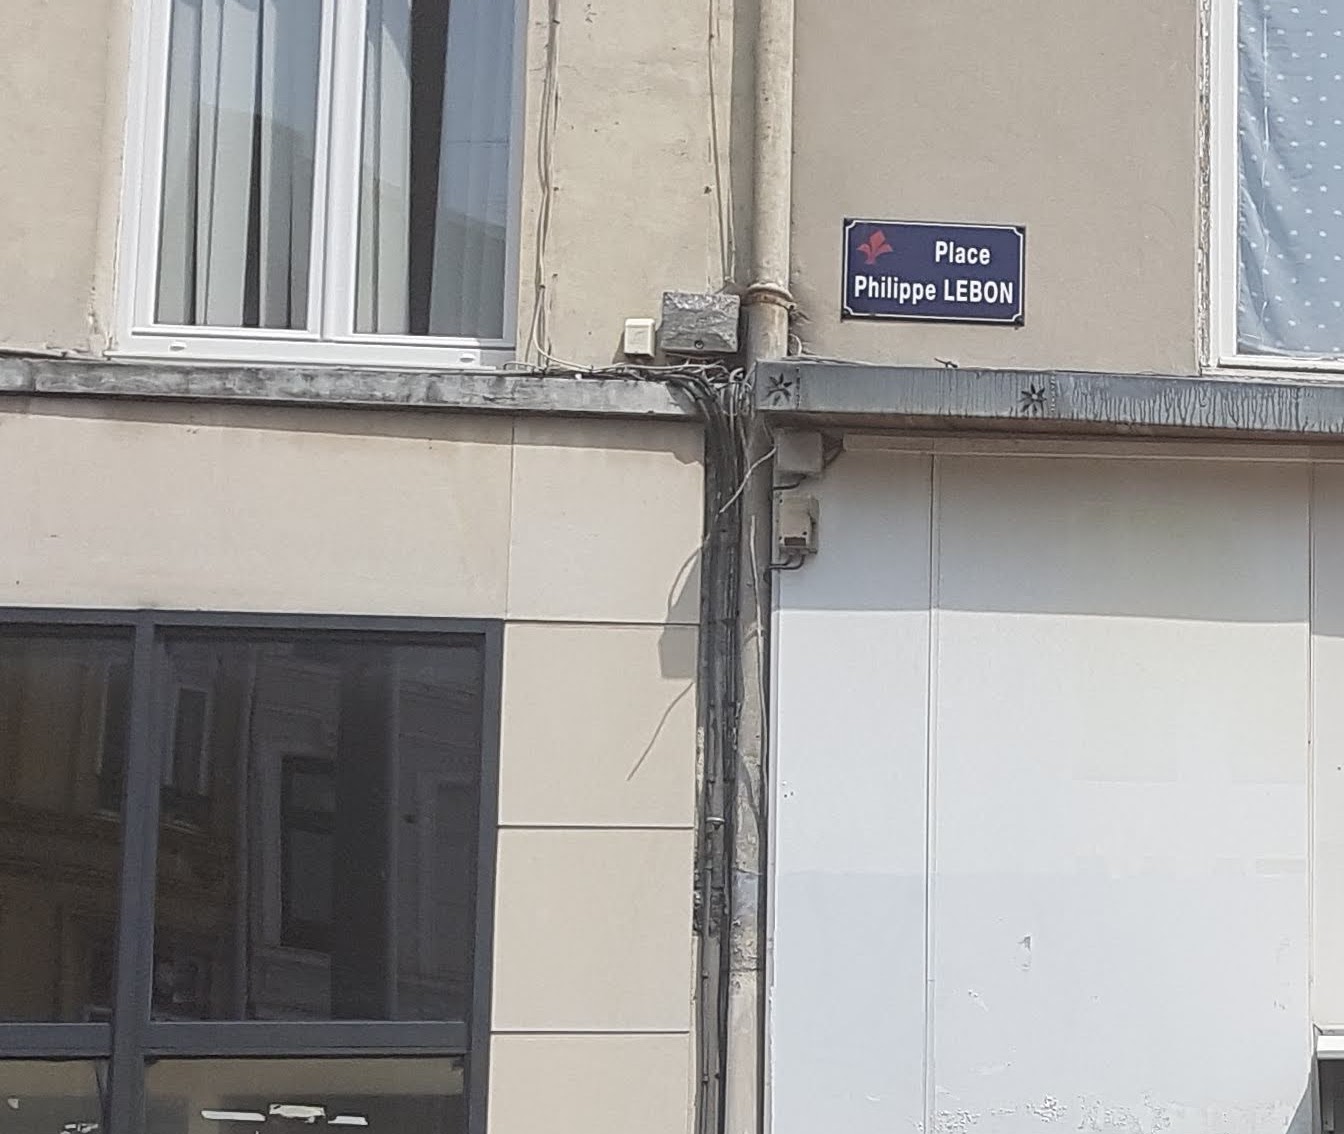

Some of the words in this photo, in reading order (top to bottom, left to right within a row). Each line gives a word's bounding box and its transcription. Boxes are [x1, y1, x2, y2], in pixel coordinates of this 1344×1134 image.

[935, 241, 990, 265] Place
[854, 275, 936, 304] Philippe
[944, 279, 1013, 304] LEBON
